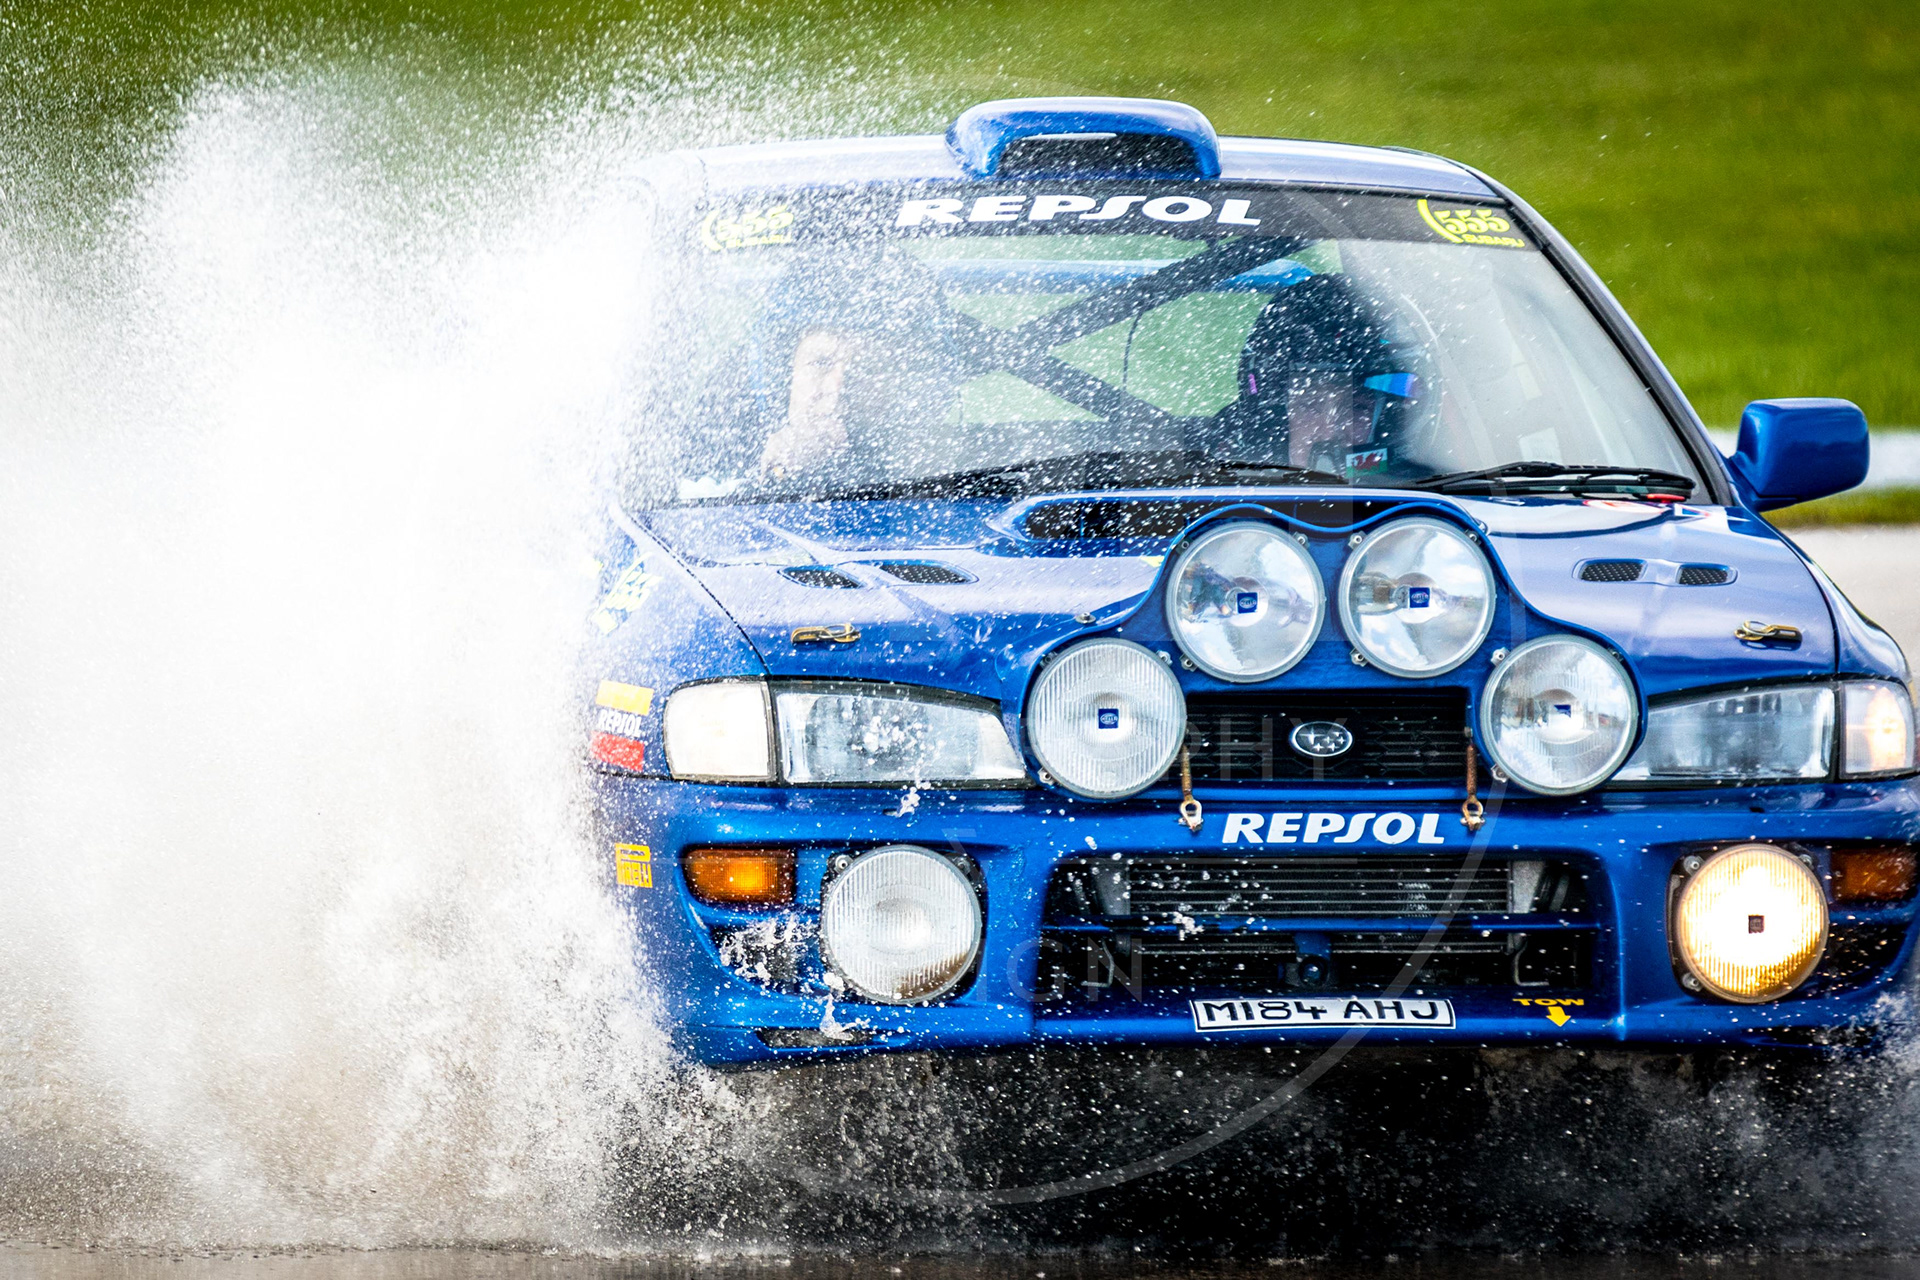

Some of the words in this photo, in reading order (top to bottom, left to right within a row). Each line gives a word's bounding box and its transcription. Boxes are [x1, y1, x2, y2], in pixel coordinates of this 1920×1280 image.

[896, 194, 1261, 226] REPSOL
[1433, 208, 1510, 234] 555
[598, 708, 643, 738] REPSOL
[1222, 812, 1444, 844] REPSOL
[1201, 1000, 1326, 1022] M184
[1343, 999, 1436, 1021] AHJ
[1513, 998, 1584, 1007] TOW
